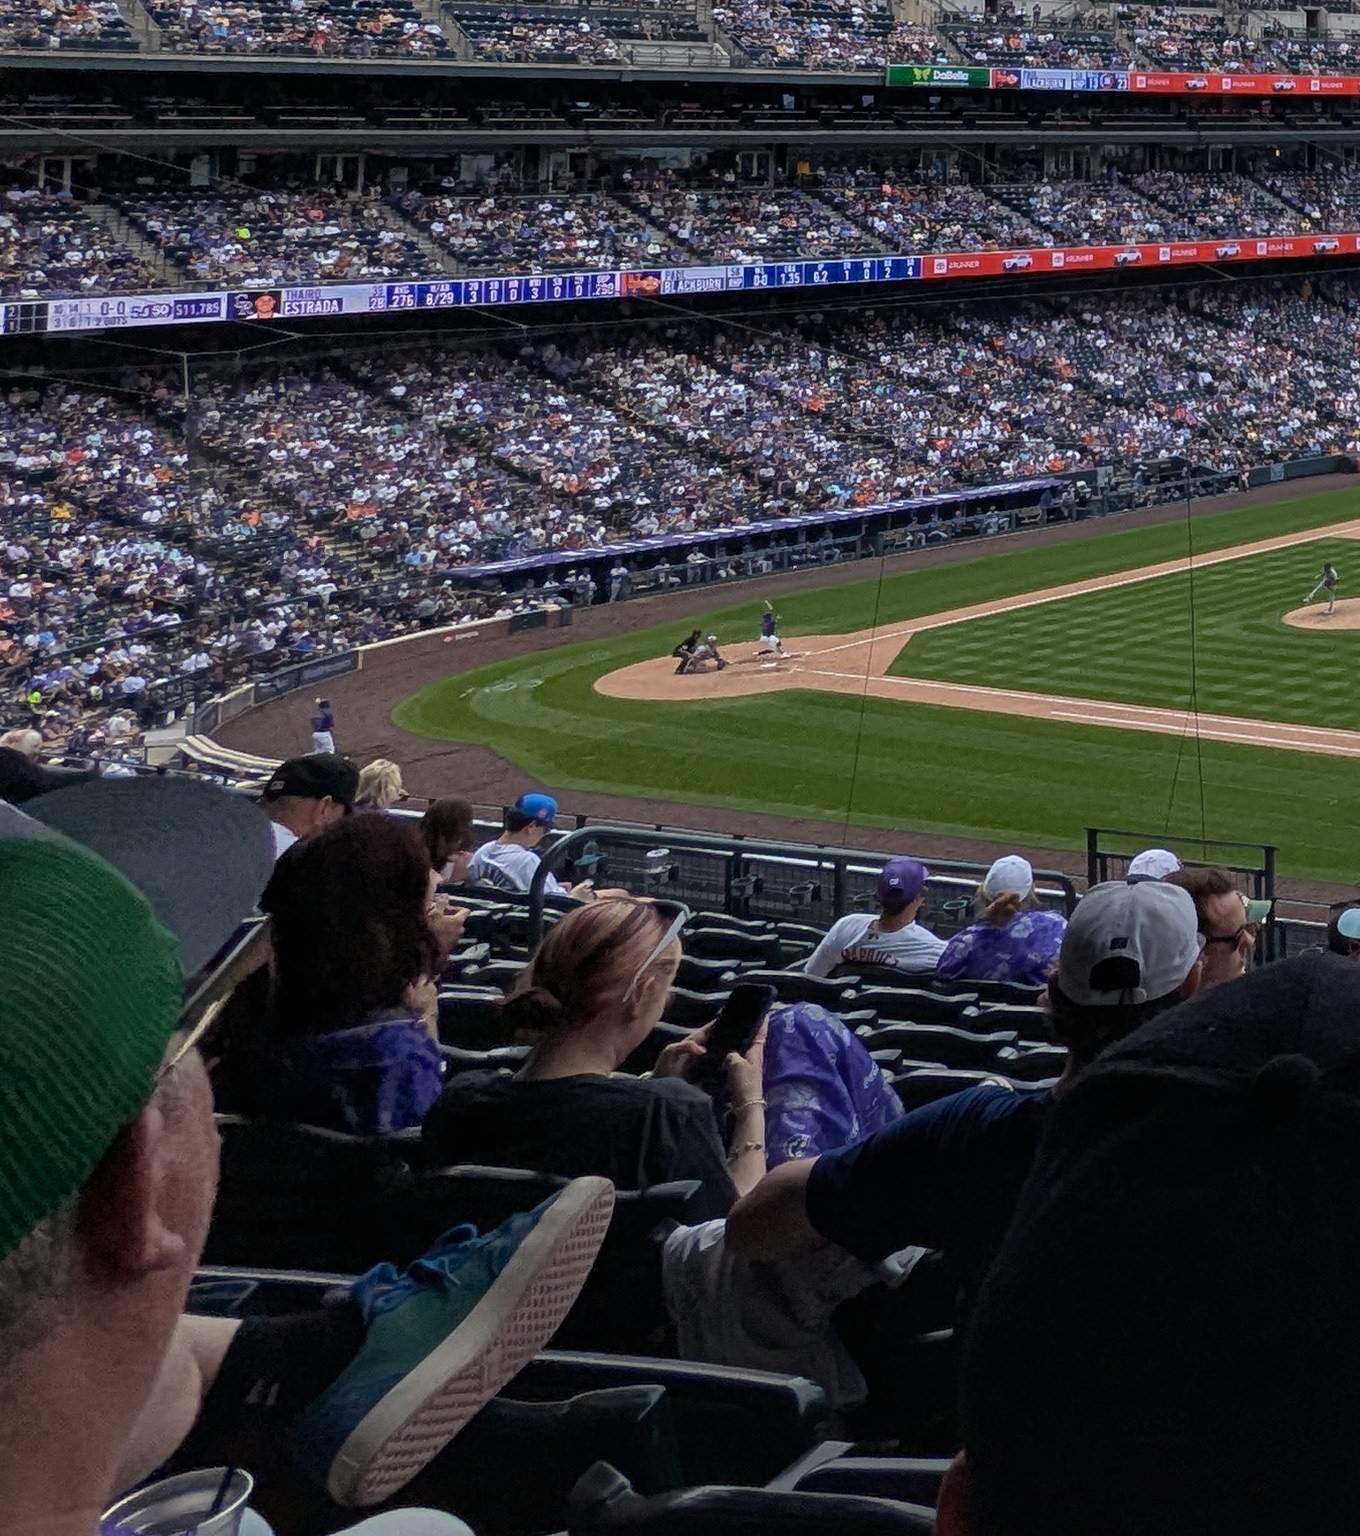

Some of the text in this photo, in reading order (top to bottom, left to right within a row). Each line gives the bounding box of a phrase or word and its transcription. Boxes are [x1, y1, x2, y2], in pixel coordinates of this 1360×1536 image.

[933, 70, 969, 80] DaBella
[780, 273, 800, 284] 1.35
[885, 267, 891, 278] 2
[907, 266, 913, 276] 4
[664, 277, 721, 293] BLACKBURN
[426, 292, 454, 306] 8/29
[470, 291, 477, 303] 3
[490, 290, 497, 302] 0
[510, 289, 517, 301] 0
[531, 287, 538, 299] 3
[554, 286, 561, 298] 0
[576, 285, 582, 296] 0
[8, 307, 15, 318] 2
[284, 296, 385, 314] ESTRADA 2B
